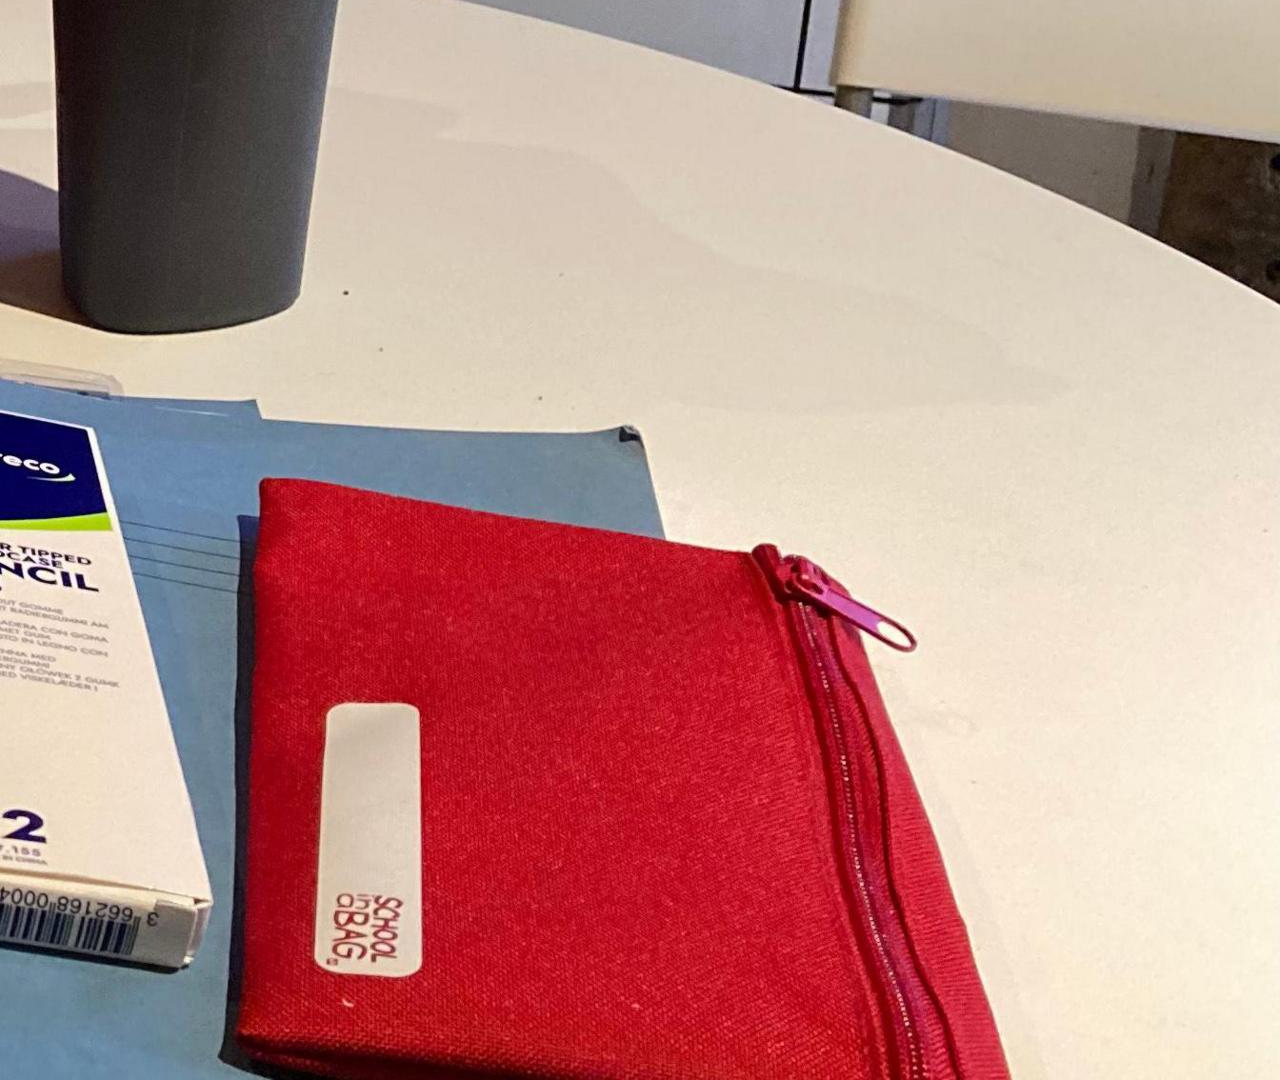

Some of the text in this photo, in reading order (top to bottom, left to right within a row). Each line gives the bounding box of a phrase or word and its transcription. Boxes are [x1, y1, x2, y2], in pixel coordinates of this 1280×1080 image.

[17, 545, 92, 566] TIPPED
[56, 896, 134, 922] 662168
[146, 911, 160, 927] 3
[331, 910, 370, 960] BAG
[370, 895, 403, 962] SCHOOL
